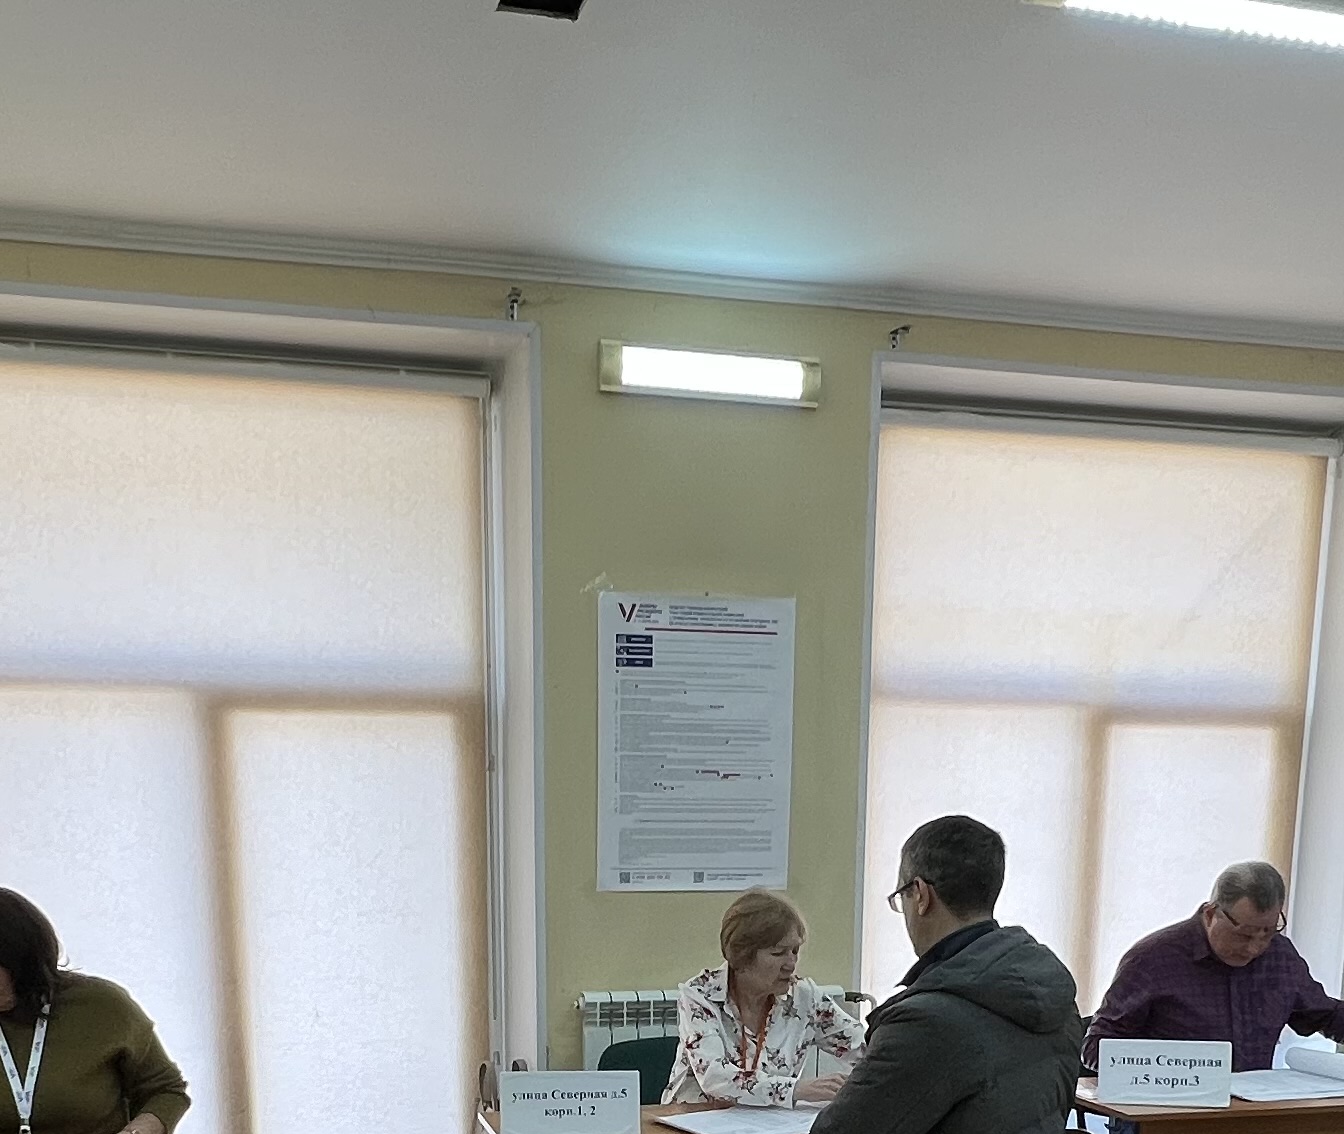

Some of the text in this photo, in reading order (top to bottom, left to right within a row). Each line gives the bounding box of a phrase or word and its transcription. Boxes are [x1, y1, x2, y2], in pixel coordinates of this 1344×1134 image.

[1109, 1054, 1222, 1070] улица Северная
[1154, 1074, 1200, 1089] корп.3
[512, 1088, 628, 1104] улица Северная д.5
[589, 1105, 596, 1116] 2
